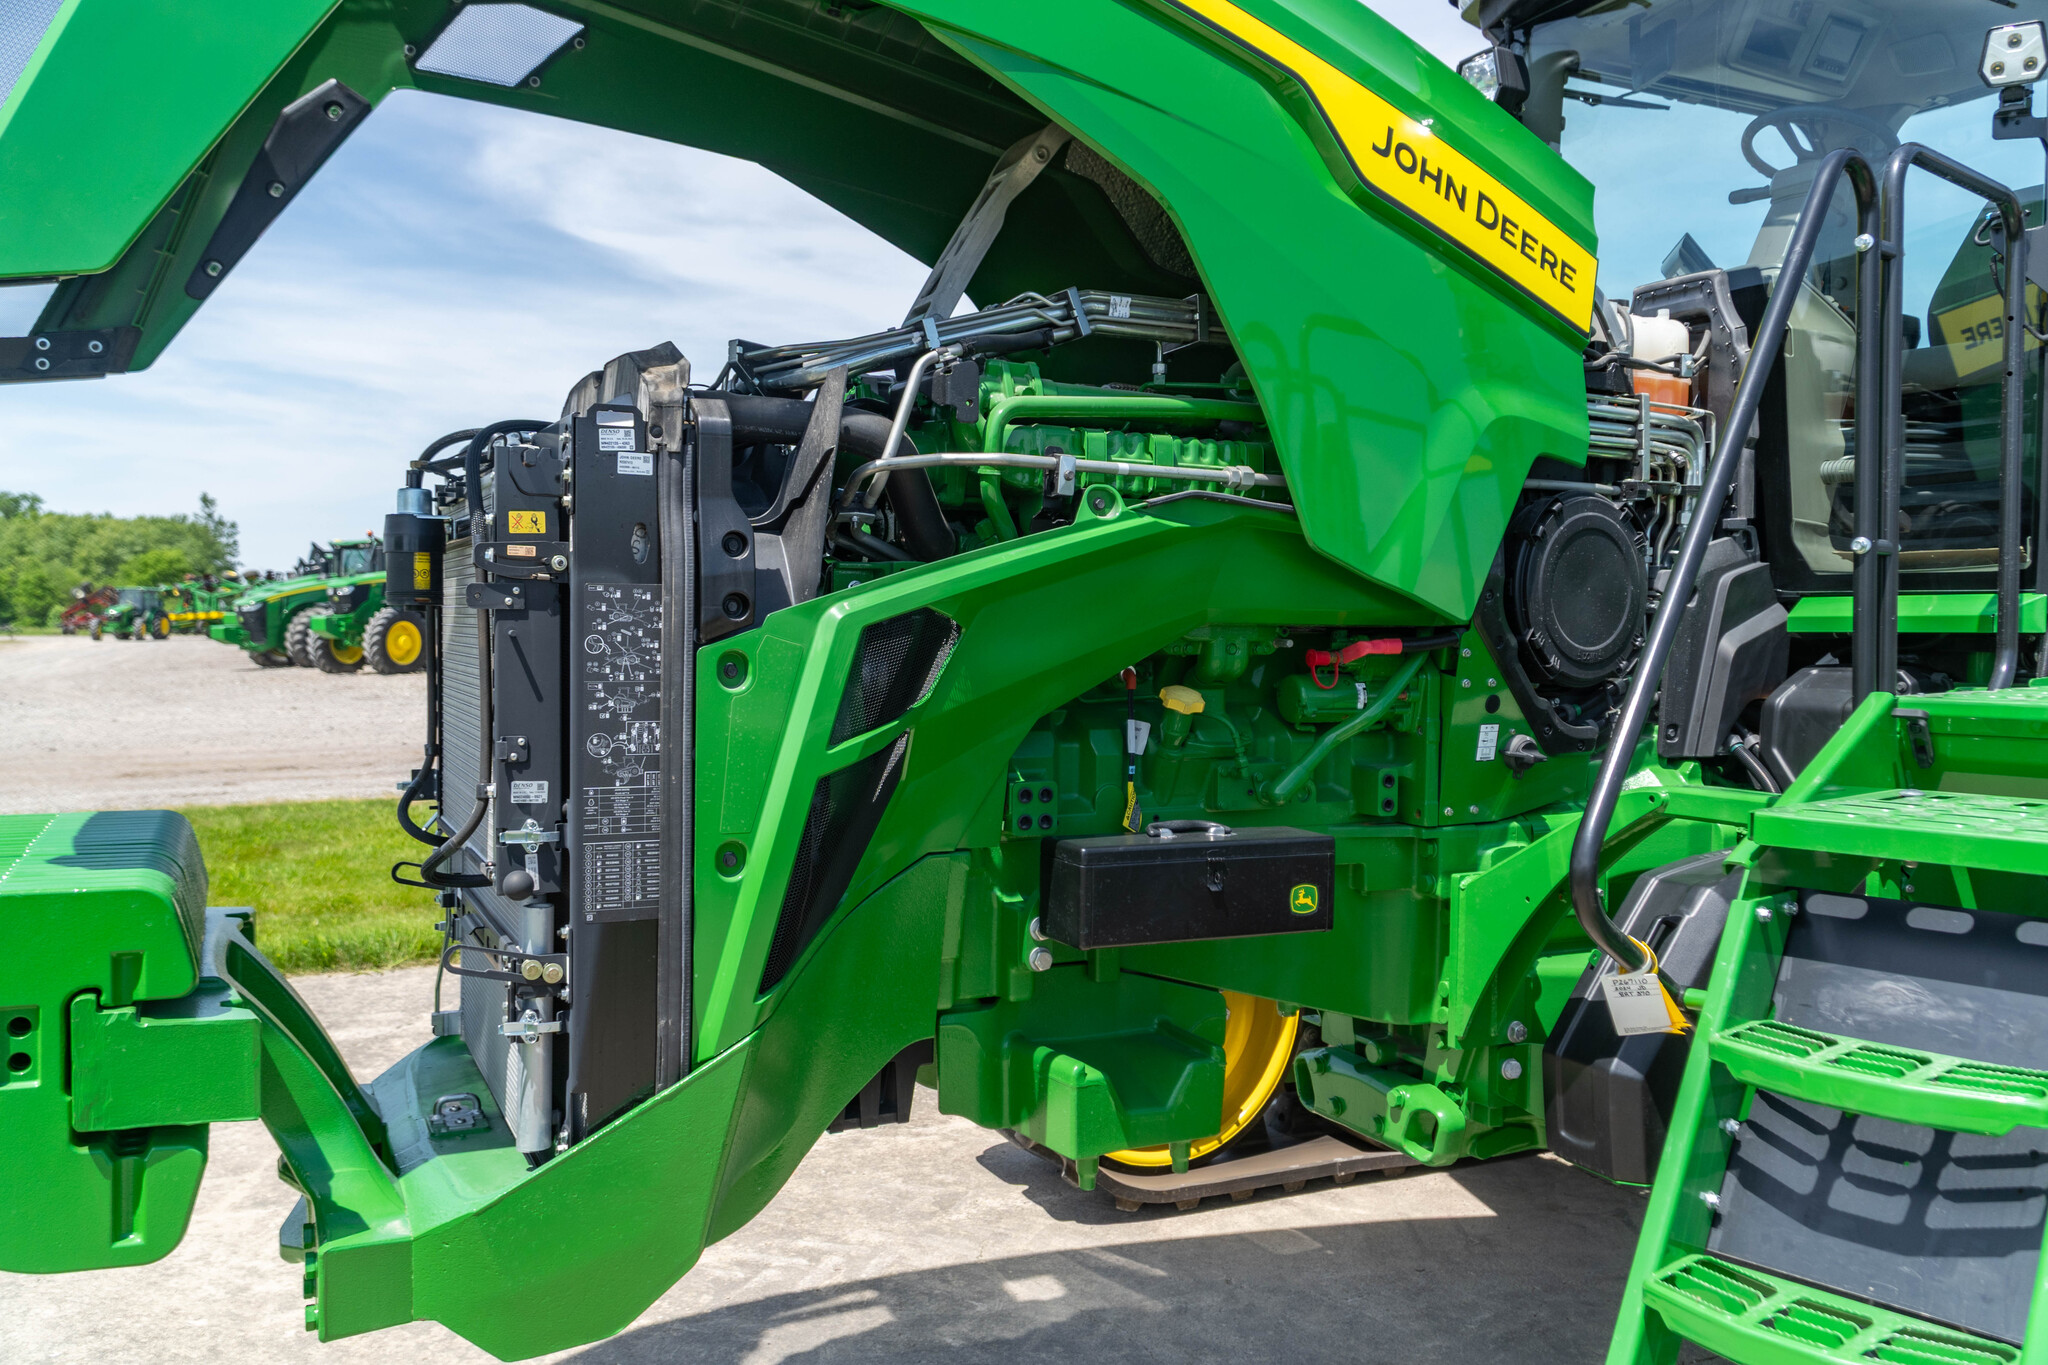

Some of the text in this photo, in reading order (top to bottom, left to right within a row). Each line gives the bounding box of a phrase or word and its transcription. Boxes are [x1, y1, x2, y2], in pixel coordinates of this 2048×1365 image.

[1372, 125, 1578, 294] JOHN DEERE
[1612, 978, 1648, 986] P267110
